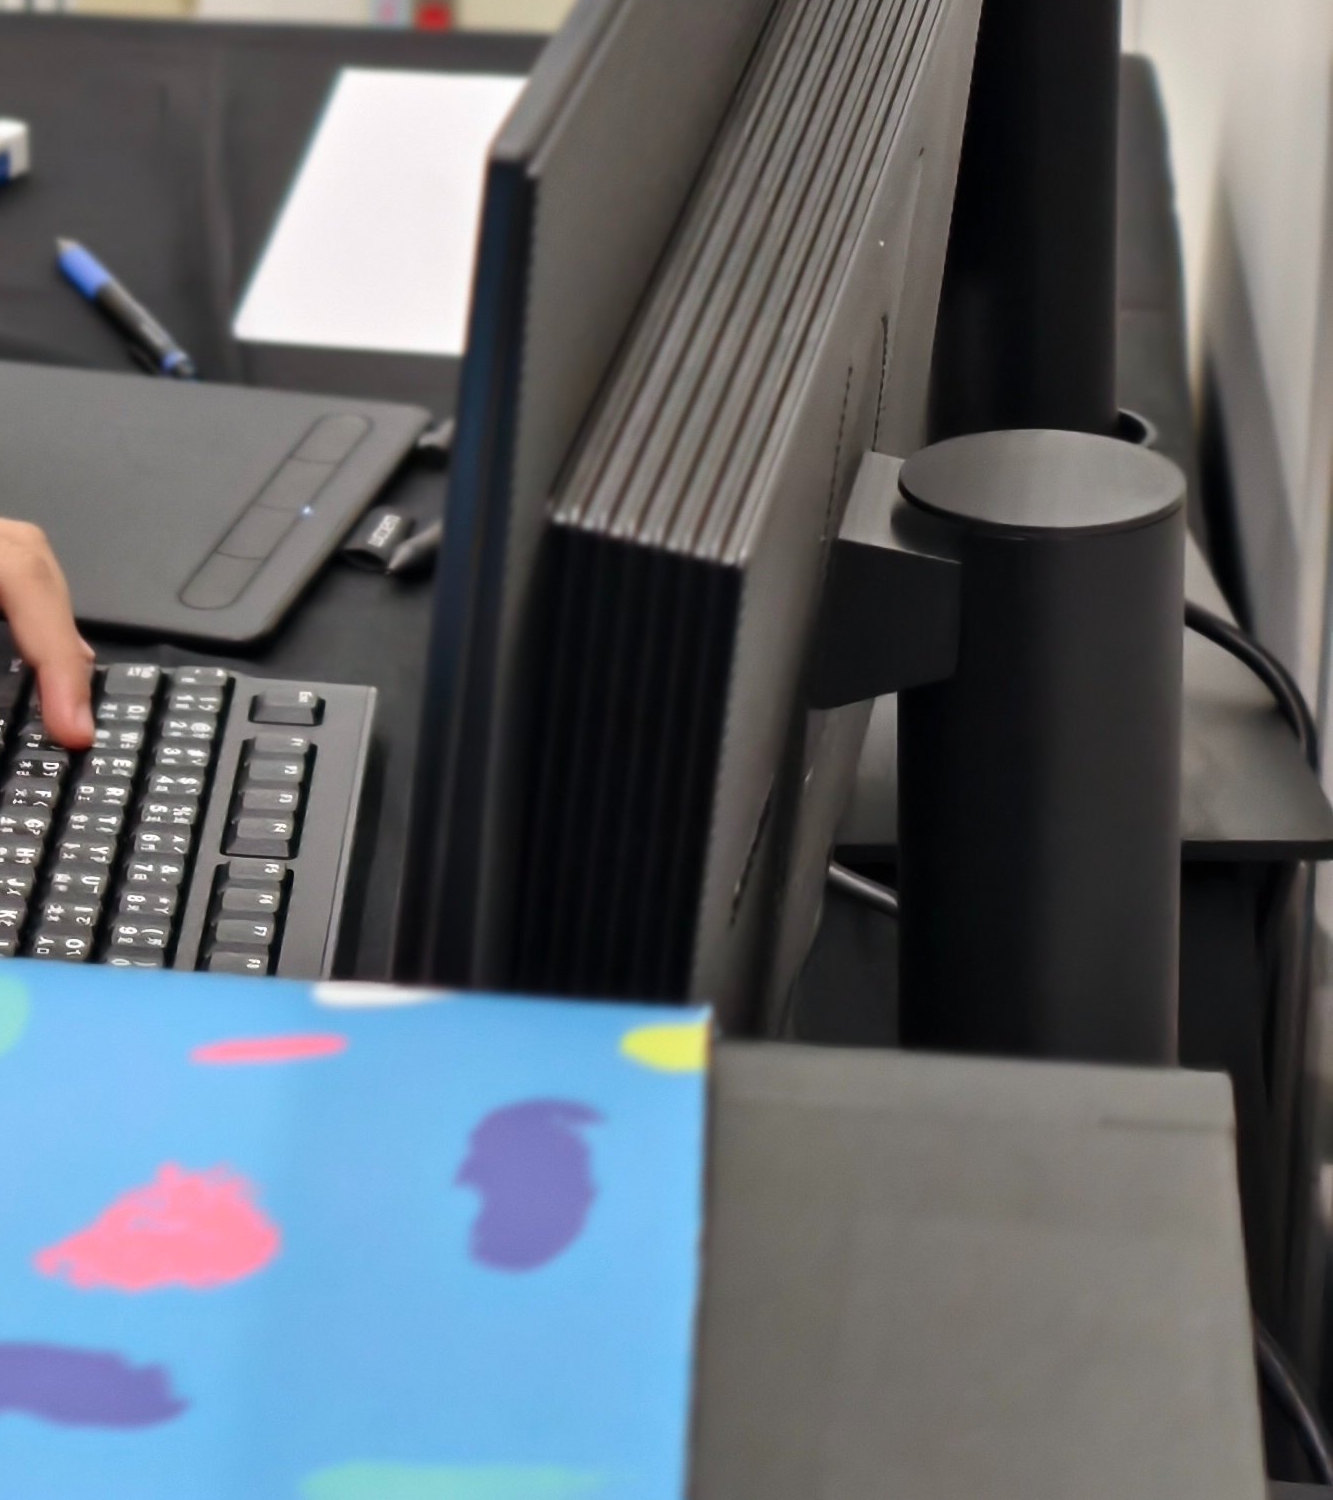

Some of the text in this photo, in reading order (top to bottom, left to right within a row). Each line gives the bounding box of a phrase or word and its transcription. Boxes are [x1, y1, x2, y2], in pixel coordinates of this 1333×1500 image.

[42, 762, 60, 770] D
[113, 759, 133, 768] E
[157, 776, 175, 784] 4
[35, 790, 52, 798] F
[105, 788, 125, 796] R
[149, 805, 168, 813] 5
[24, 819, 45, 830] G
[99, 817, 118, 825] T
[273, 824, 288, 833] F4
[141, 834, 161, 842] 6
[15, 848, 36, 857] H
[90, 847, 109, 855] Y
[135, 864, 153, 872] 7
[264, 864, 280, 874] F5
[7, 878, 26, 887] J
[81, 876, 101, 885] U
[258, 894, 275, 904] F6
[119, 927, 138, 935] 9
[254, 925, 269, 937] F7
[66, 938, 85, 948] O
